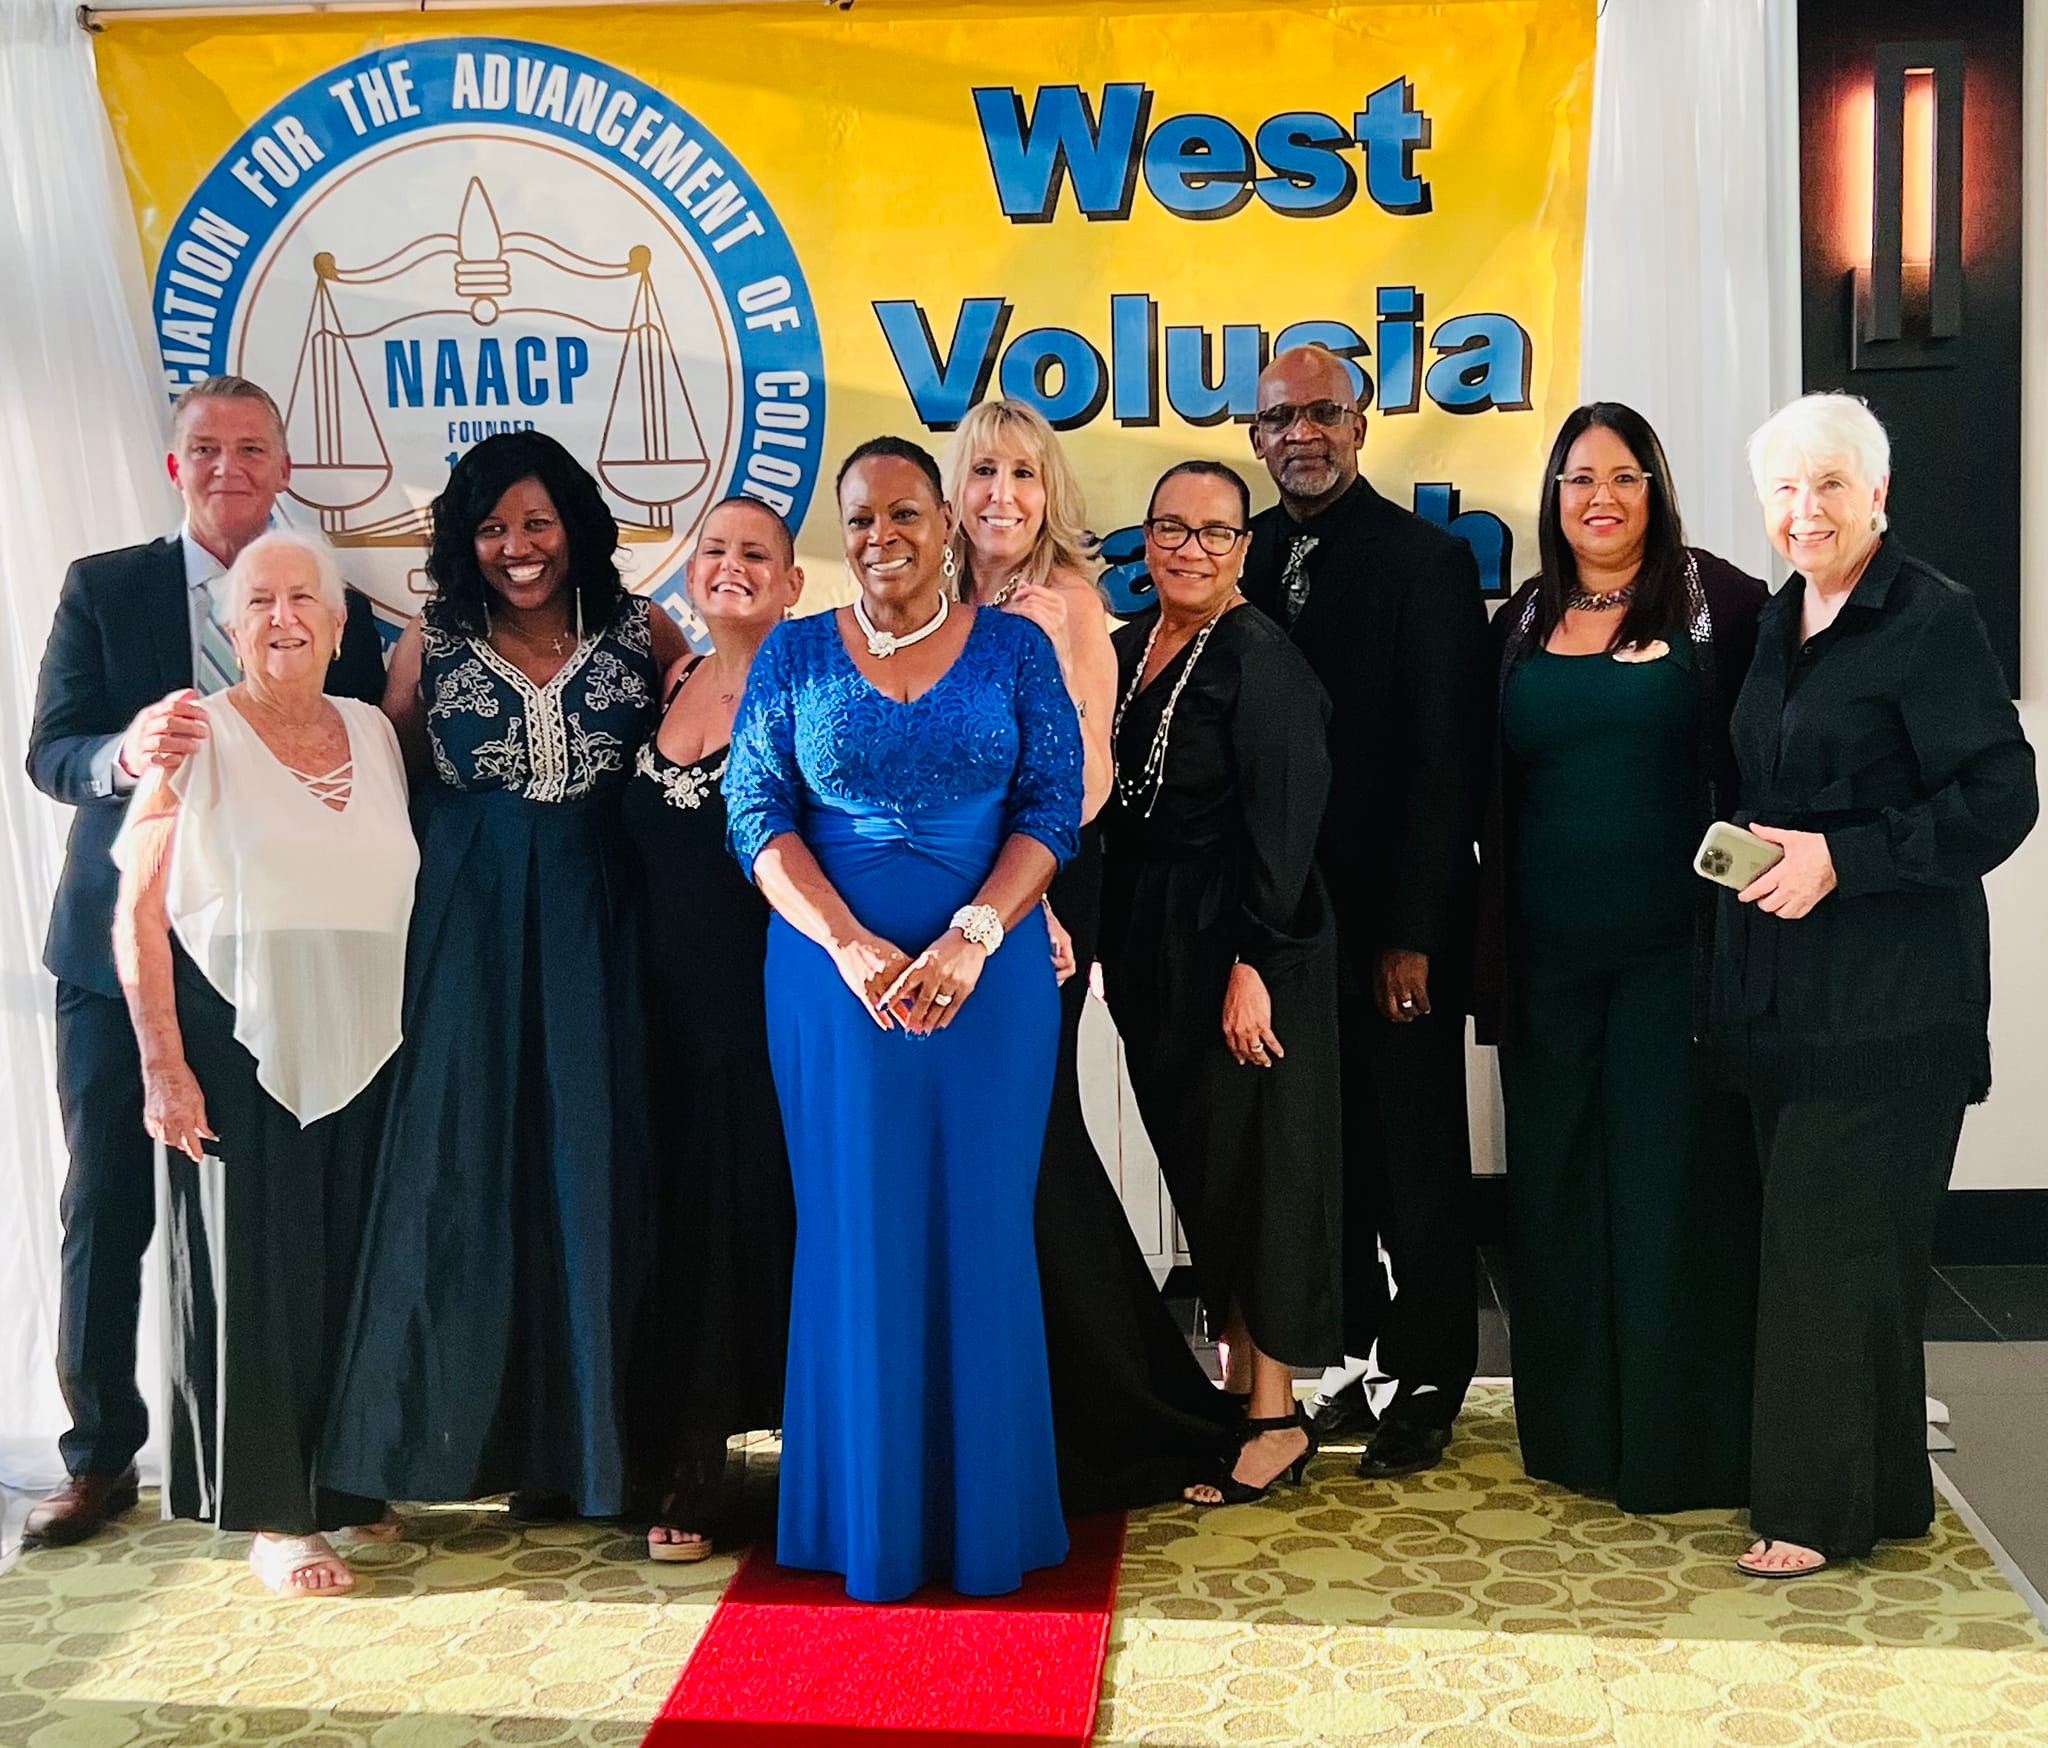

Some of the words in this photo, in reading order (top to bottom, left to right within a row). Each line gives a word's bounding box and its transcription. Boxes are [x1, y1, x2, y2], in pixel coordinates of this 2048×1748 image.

[328, 59, 421, 136] THE
[230, 115, 326, 209] FOR
[452, 52, 766, 254] ADVANCEMENT
[971, 75, 1434, 224] West
[737, 275, 801, 333] OF
[384, 336, 590, 408] NAACP
[740, 370, 811, 519] COLOR
